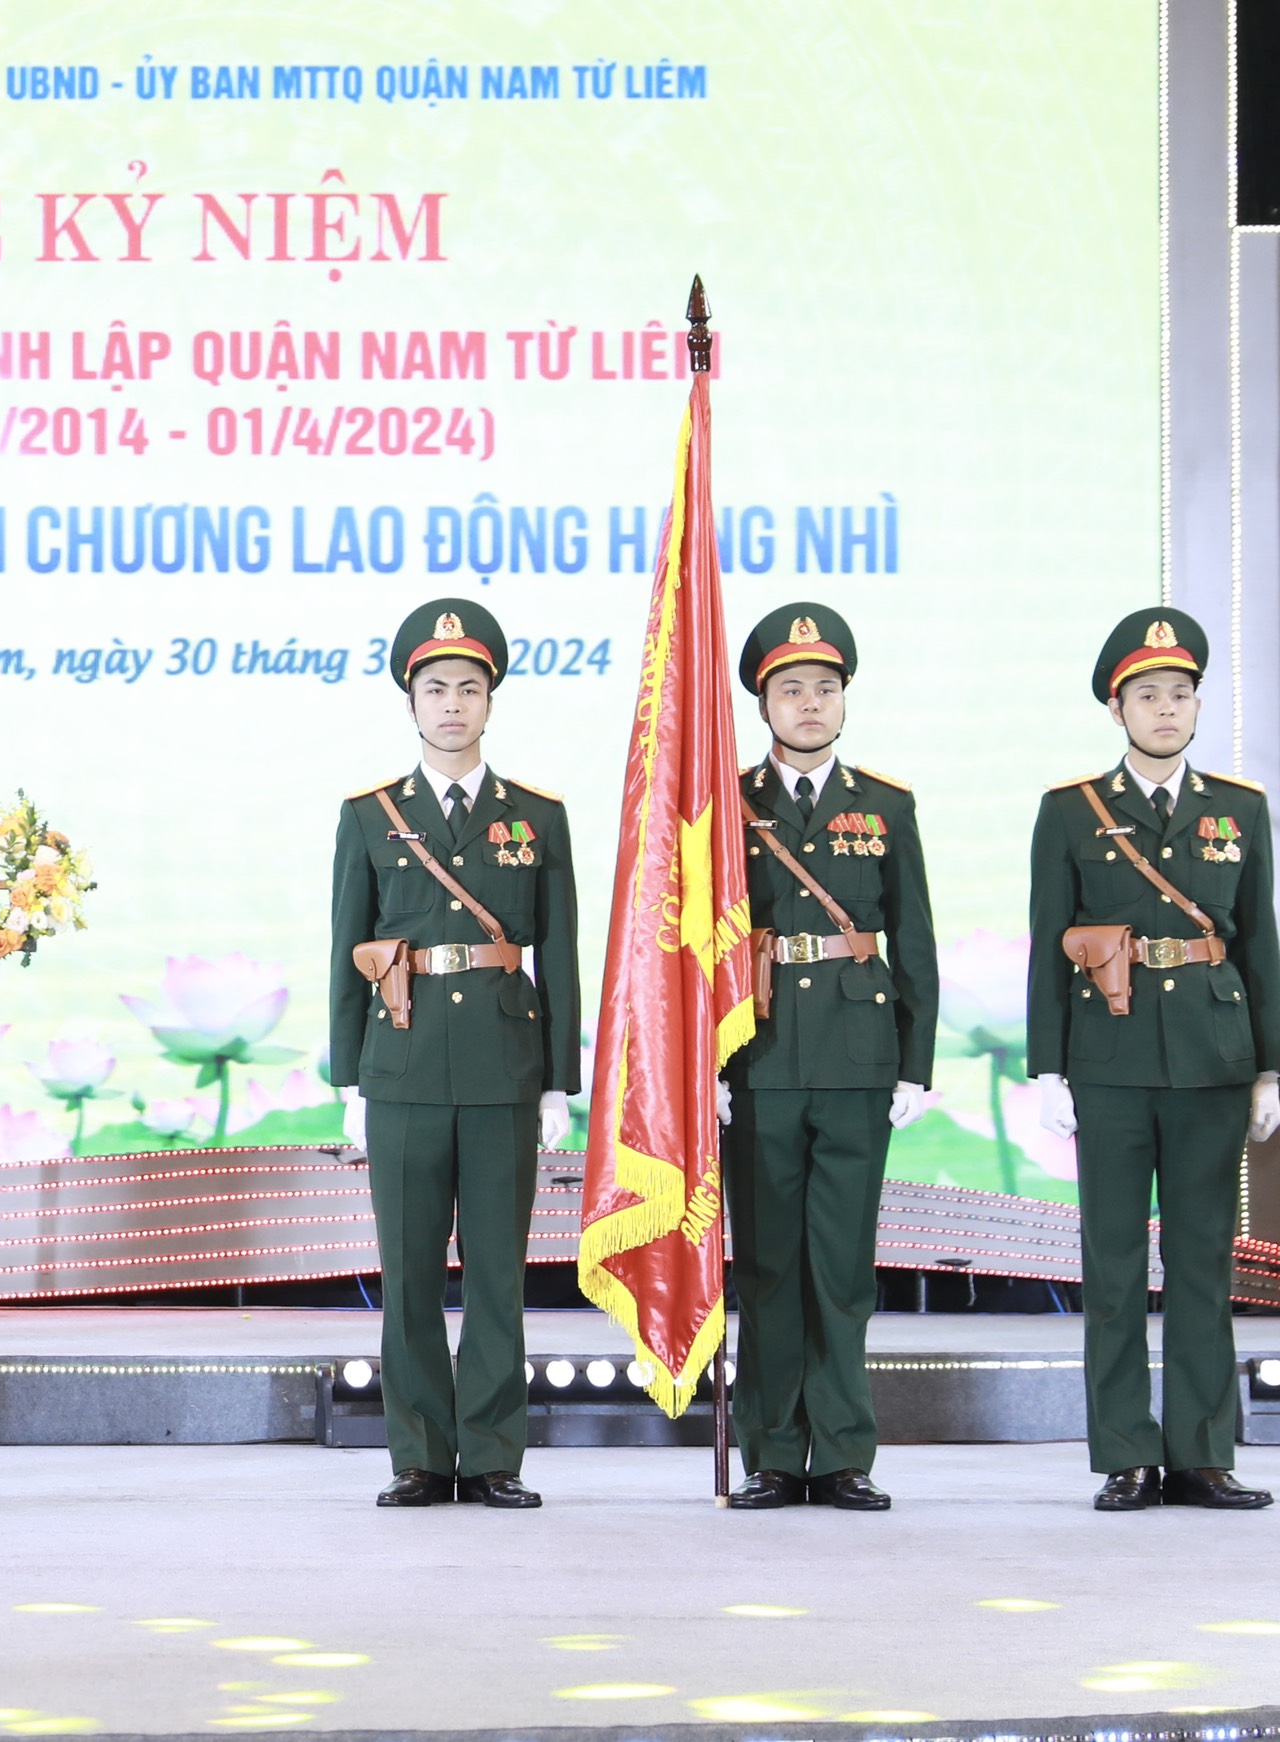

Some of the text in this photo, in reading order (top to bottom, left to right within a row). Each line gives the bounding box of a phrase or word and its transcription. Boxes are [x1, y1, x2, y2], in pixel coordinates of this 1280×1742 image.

[6, 65, 100, 102] UBND
[111, 81, 124, 90] -
[136, 53, 179, 102] ỦY
[190, 64, 261, 101] BAN
[272, 64, 364, 105] MTTQ
[376, 56, 469, 109] QUẬN
[480, 64, 560, 101] NAM
[571, 58, 616, 101] TỪ
[625, 57, 708, 101] LIÊM
[34, 159, 167, 263] KỶ
[192, 167, 449, 284] NIỆM
[72, 319, 172, 392] LẬP
[192, 319, 340, 392] QUẬN
[361, 330, 488, 381] NAM
[506, 319, 578, 381] TỪ
[168, 429, 188, 441] -
[207, 405, 496, 463] 01/4/2024)
[26, 502, 272, 575] CHƯƠNG
[293, 504, 404, 575] LAO
[422, 491, 588, 586] ĐỘNG
[609, 503, 776, 575] HNG
[795, 491, 900, 575] NHÌ
[51, 637, 154, 685] ngày
[165, 636, 219, 677] 30
[231, 637, 350, 685] tháng
[362, 637, 389, 677] 3
[506, 637, 612, 677] 2024
